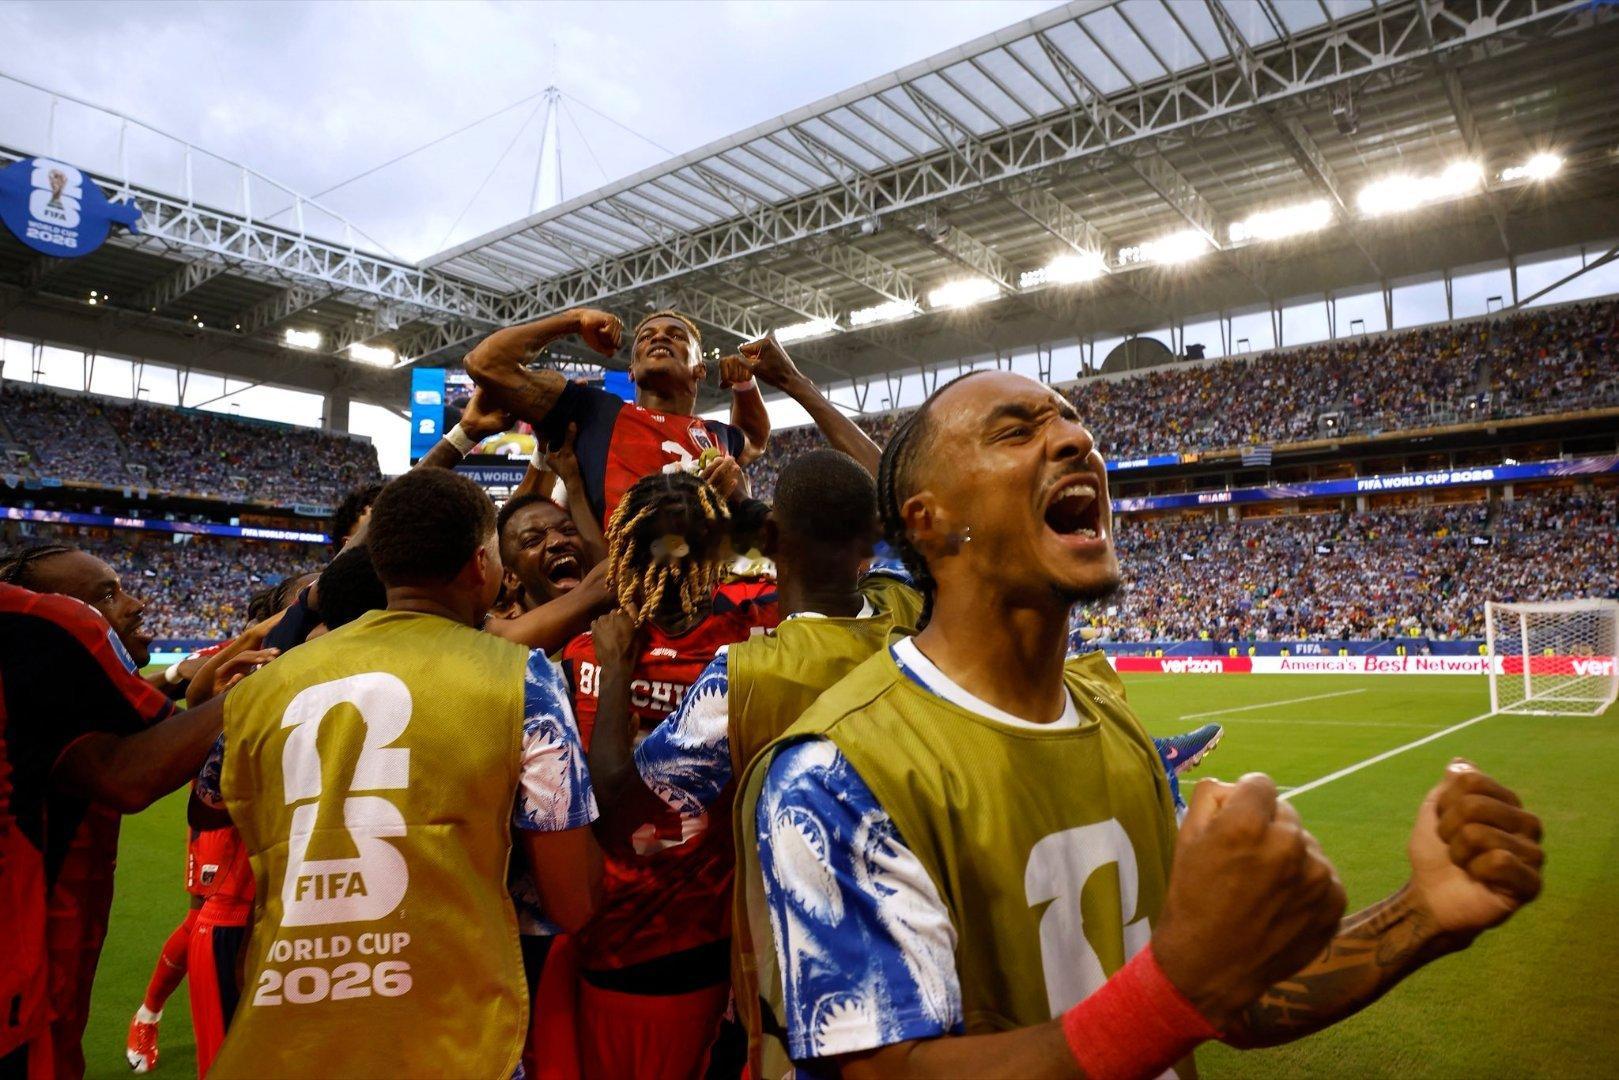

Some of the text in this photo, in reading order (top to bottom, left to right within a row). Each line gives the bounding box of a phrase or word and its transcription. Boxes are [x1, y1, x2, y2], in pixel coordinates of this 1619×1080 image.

[26, 227, 78, 248] 2026
[482, 472, 524, 482] WORLD
[1357, 469, 1495, 491] FIFA WORLD CUP 2026
[1198, 492, 1232, 504] MIAMI
[114, 517, 145, 528] MIAMI
[241, 528, 258, 537] FIFA
[258, 529, 284, 539] WORLD
[284, 531, 299, 540] CUP
[1295, 643, 1321, 654] FIFA
[1161, 656, 1223, 673] verizon
[1280, 658, 1357, 671] America's
[1364, 655, 1409, 672] Best
[1416, 658, 1490, 671] Network
[294, 871, 368, 902] FIFA
[356, 931, 411, 956] CUP
[252, 960, 413, 1007] 2026
